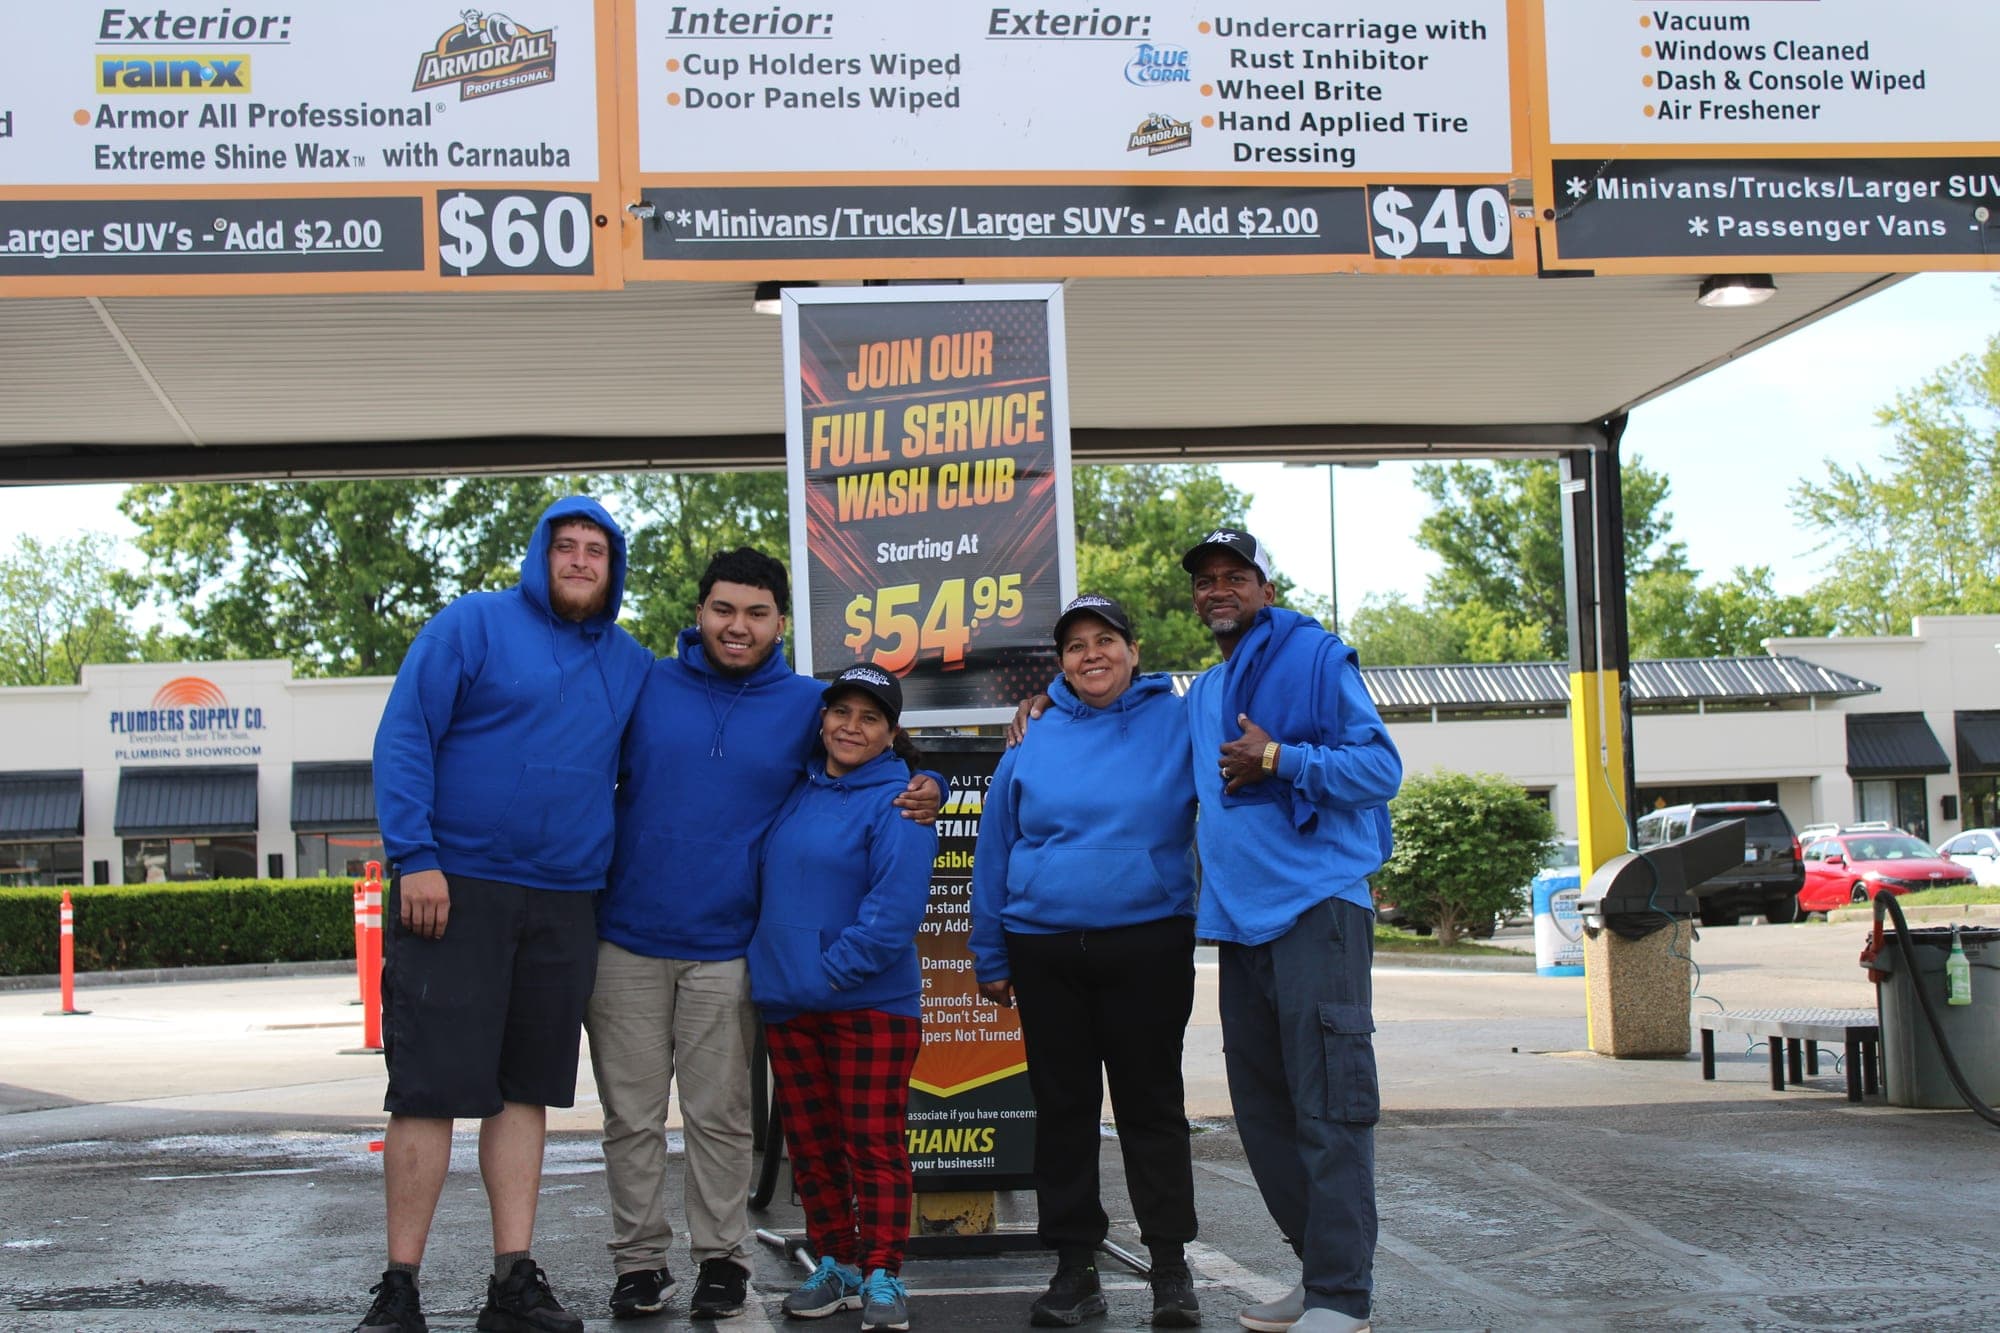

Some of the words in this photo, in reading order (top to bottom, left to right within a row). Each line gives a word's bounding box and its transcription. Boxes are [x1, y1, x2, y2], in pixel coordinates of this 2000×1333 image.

[98, 8, 291, 41] Exterior:
[667, 6, 834, 36] Interior:
[987, 8, 1152, 37] Exterior:
[1214, 17, 1417, 43] Undercarriage
[1425, 19, 1487, 40] with
[1653, 11, 1750, 31] Vacuum
[1230, 49, 1295, 69] Rust
[1303, 49, 1429, 70] Inhibitor
[1655, 40, 1767, 61] Windows
[1773, 40, 1870, 61] Cleaned
[682, 53, 739, 80] Cup
[749, 54, 861, 75] Holders
[870, 53, 961, 80] Wiped
[1216, 79, 1304, 100] Wheel
[1314, 80, 1383, 101] Brite
[1657, 70, 1717, 90] Dash
[1724, 71, 1741, 90] &
[1748, 70, 1844, 90] Console
[1849, 69, 1926, 95] Wiped
[685, 87, 756, 109] Door
[764, 87, 861, 109] Panels
[869, 87, 961, 113] Wiped
[1658, 100, 1692, 120] Air
[1699, 100, 1821, 120] Freshener
[95, 103, 190, 129] Armor
[198, 103, 237, 129] All
[1218, 111, 1290, 131] Hand
[1299, 112, 1405, 136] Applied
[1413, 112, 1468, 133] Tire
[94, 144, 206, 170] Extreme
[214, 143, 287, 169] Shine
[382, 142, 441, 168] with
[446, 141, 571, 168] Carnauba
[1233, 142, 1356, 168] Dressing
[439, 192, 590, 276] $60
[1063, 206, 1146, 235] SUV's
[1174, 207, 1229, 235] Add
[1238, 206, 1318, 239] $2.00
[1372, 186, 1511, 260] $40
[1718, 215, 1870, 240] Passenger
[1877, 214, 1947, 236] Vans
[102, 222, 193, 252] SUV's
[223, 220, 284, 250] Add
[294, 219, 382, 254] $2.00
[847, 338, 922, 392] JOIN
[929, 330, 993, 381] OUR
[810, 408, 890, 470] FULL
[901, 390, 1045, 459] SERVICE
[836, 466, 928, 523] WASH
[937, 456, 1016, 511] CLUB
[876, 537, 953, 564] Starting
[956, 533, 979, 555] At
[110, 709, 184, 733] PLUMBERS
[189, 707, 239, 730] SUPPLY
[245, 707, 267, 730] CO.
[129, 733, 178, 744] Everything
[115, 748, 181, 760] PLUMBING
[185, 745, 262, 758] SHOWROOM
[934, 820, 980, 837] ETAIL
[930, 884, 948, 896] ars
[951, 884, 964, 895] or
[922, 956, 972, 973] Damage
[920, 992, 972, 1007] Sunroofs
[937, 1009, 970, 1023] Don't
[972, 1008, 997, 1023] Seal
[922, 1029, 951, 1047] ipers
[955, 1028, 976, 1042] Not
[979, 1027, 1021, 1041] Turned
[907, 1110, 948, 1121] associate
[950, 1109, 957, 1119] if
[958, 1111, 975, 1121] you
[977, 1108, 998, 1119] have
[905, 1127, 996, 1154] HANKS
[911, 1159, 936, 1172] your
[938, 1157, 995, 1169] business!!!
